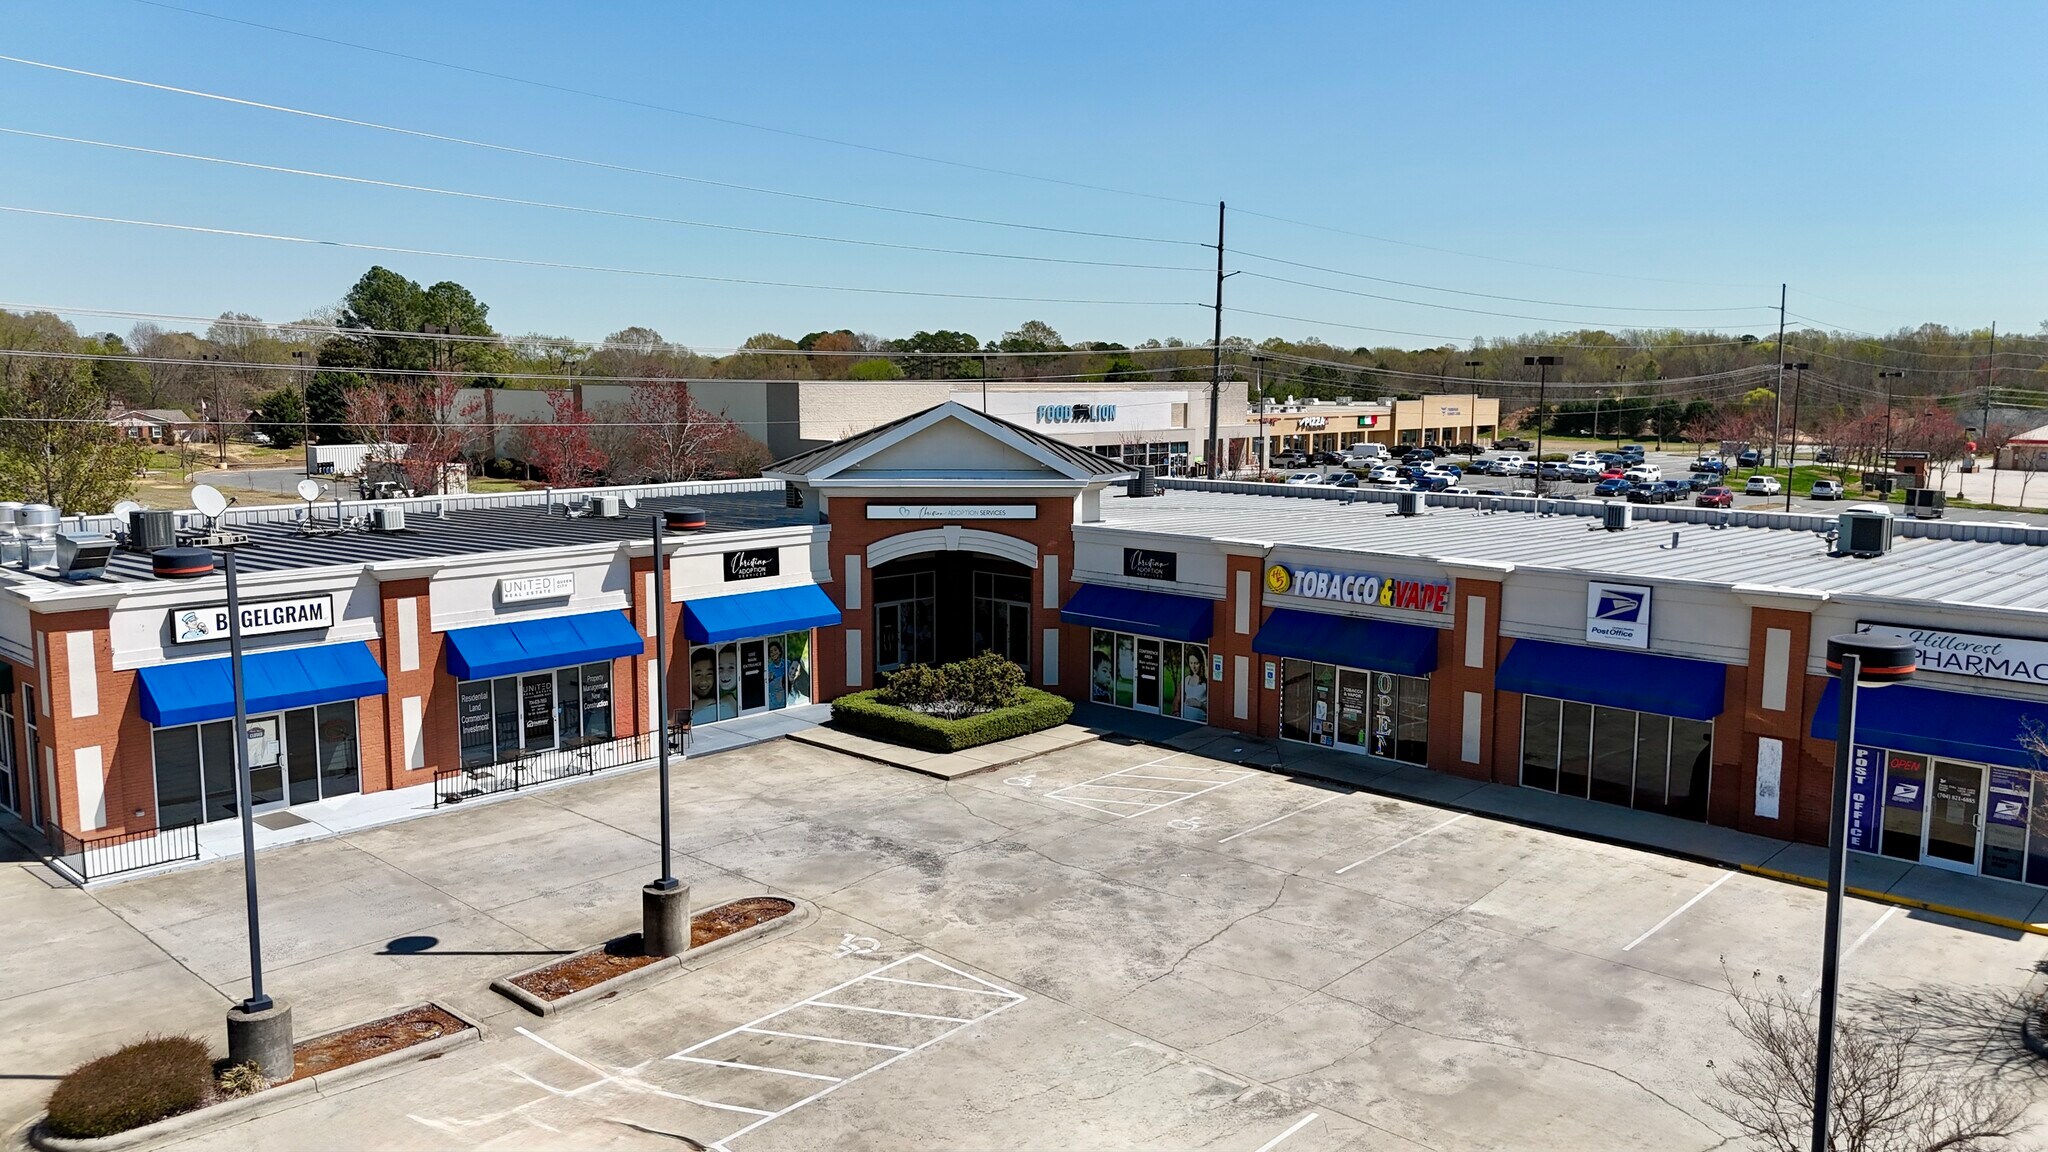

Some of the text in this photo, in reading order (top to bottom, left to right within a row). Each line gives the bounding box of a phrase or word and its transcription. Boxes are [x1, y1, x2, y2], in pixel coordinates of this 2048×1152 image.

[1036, 404, 1117, 423] FOOD LION
[947, 508, 979, 516] ADOPTION
[979, 508, 1006, 516] SERVICES
[731, 551, 772, 574] Christian
[1130, 549, 1169, 570] Christian
[1137, 566, 1163, 575] ADOPTION
[1275, 576, 1284, 589] 5
[1294, 571, 1448, 612] TOBACCO & VAPE
[215, 603, 323, 631] BGELGRAM
[1592, 627, 1633, 637] Post Office
[1909, 630, 2003, 656] Hillcrest
[587, 674, 604, 683] Property
[583, 682, 609, 692] Management
[1342, 686, 1364, 694] TOBACCO
[461, 691, 489, 703] Residential
[468, 703, 482, 712] Land
[583, 699, 609, 710] Construction
[461, 712, 490, 724] Commercial
[1375, 673, 1393, 755] OPEN
[462, 723, 489, 734] Investment
[1854, 749, 1869, 784] POST
[1890, 757, 1921, 771] OPEN
[1937, 792, 1951, 800] (704)
[1850, 792, 1866, 846] OFFICE
